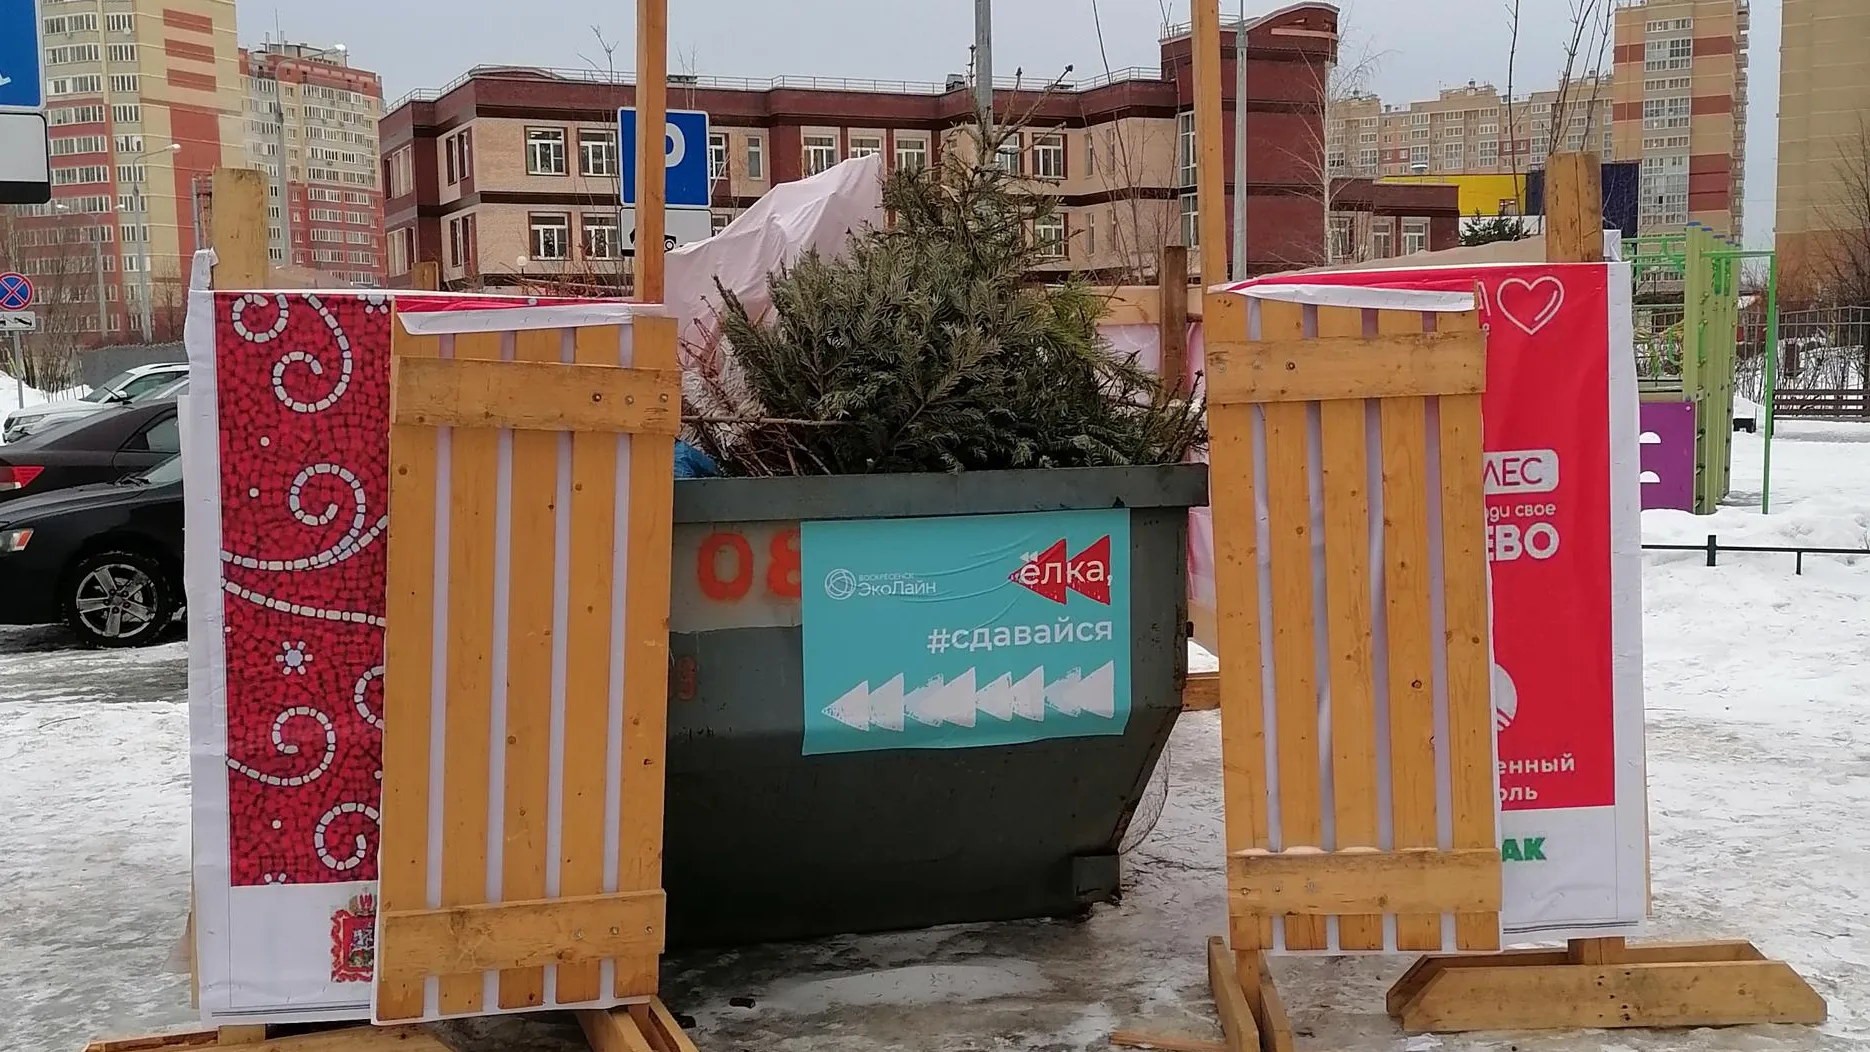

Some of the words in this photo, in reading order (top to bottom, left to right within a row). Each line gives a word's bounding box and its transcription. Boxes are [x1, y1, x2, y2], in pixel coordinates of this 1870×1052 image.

[1484, 457, 1543, 487] ЛЕС
[1514, 503, 1556, 517] свое
[858, 580, 937, 597] ЭкоЛайн
[927, 616, 1113, 654] #сдавайся
